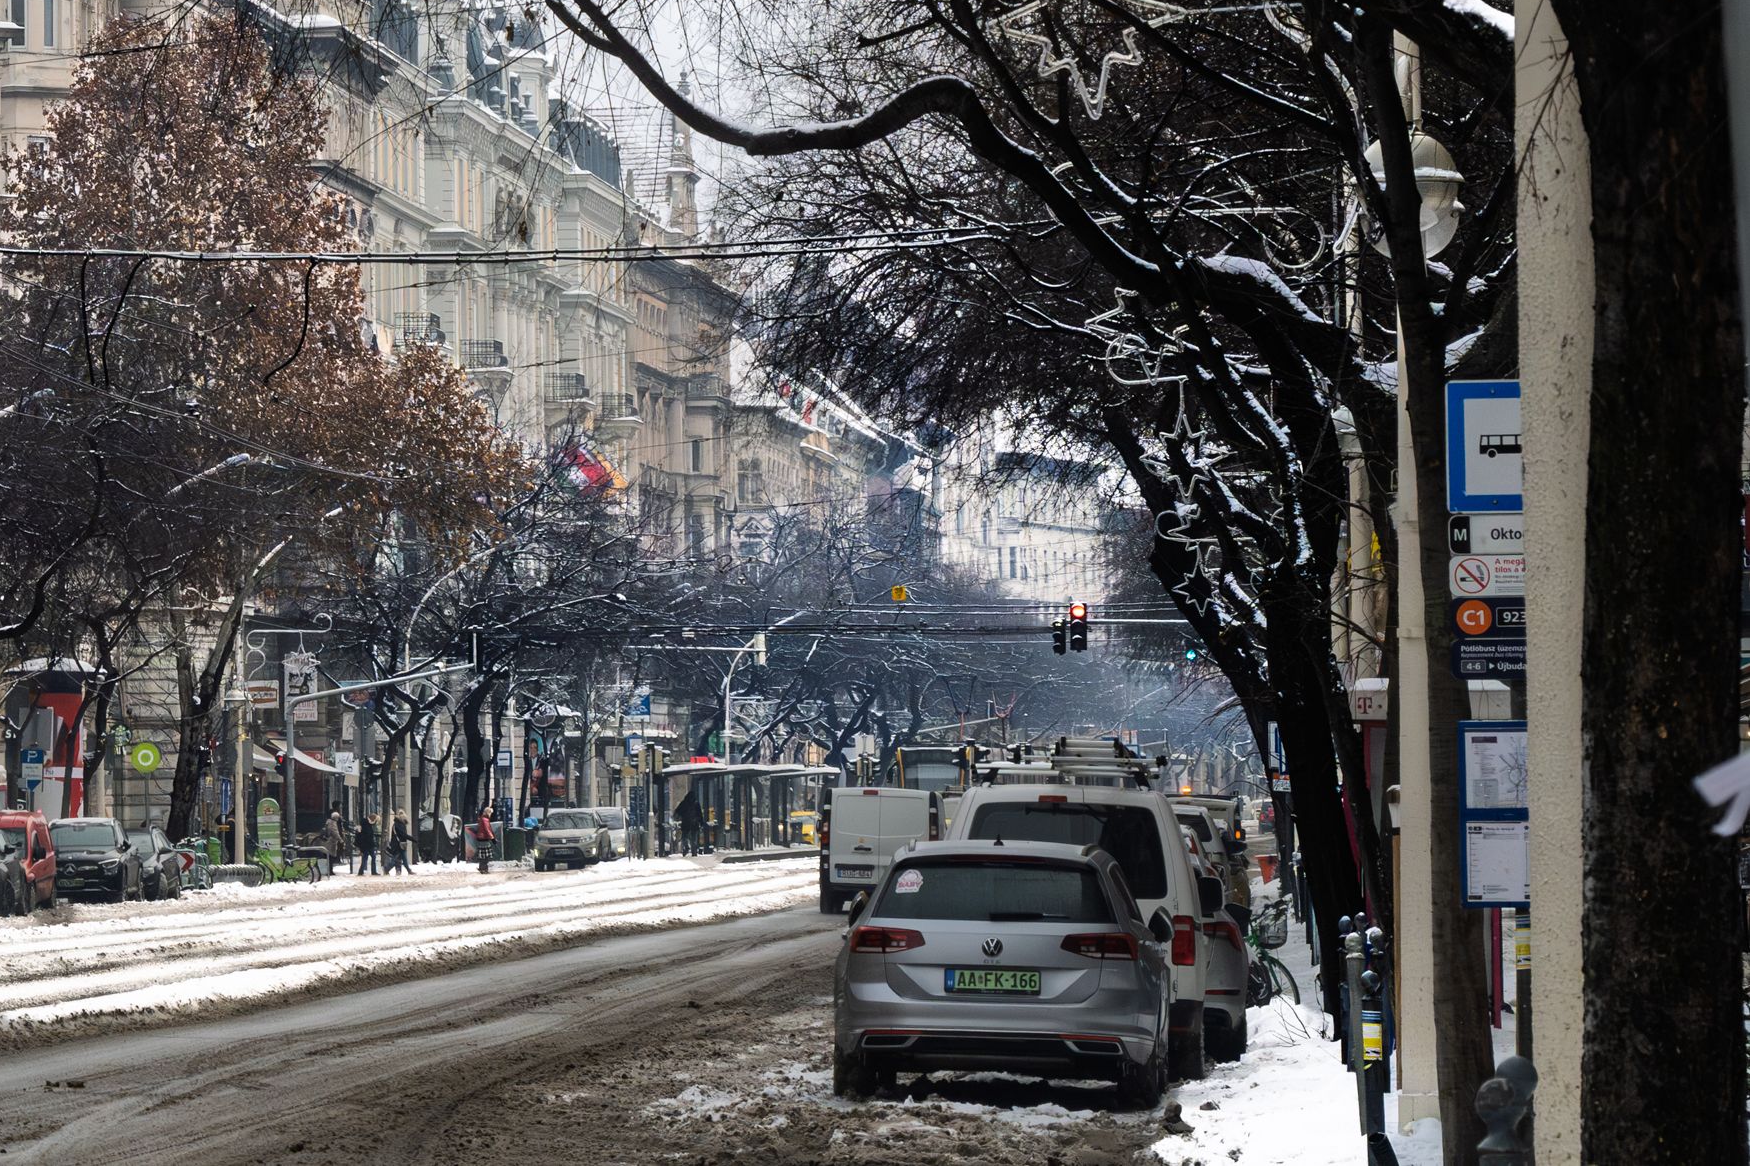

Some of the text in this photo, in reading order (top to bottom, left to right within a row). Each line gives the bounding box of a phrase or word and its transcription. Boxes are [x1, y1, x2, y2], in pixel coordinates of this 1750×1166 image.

[1453, 528, 1468, 541] M
[1490, 527, 1525, 541] Okto
[1503, 557, 1526, 567] megá
[1461, 610, 1486, 626] C1
[1502, 611, 1526, 624] 923
[1466, 662, 1481, 671] 4-6
